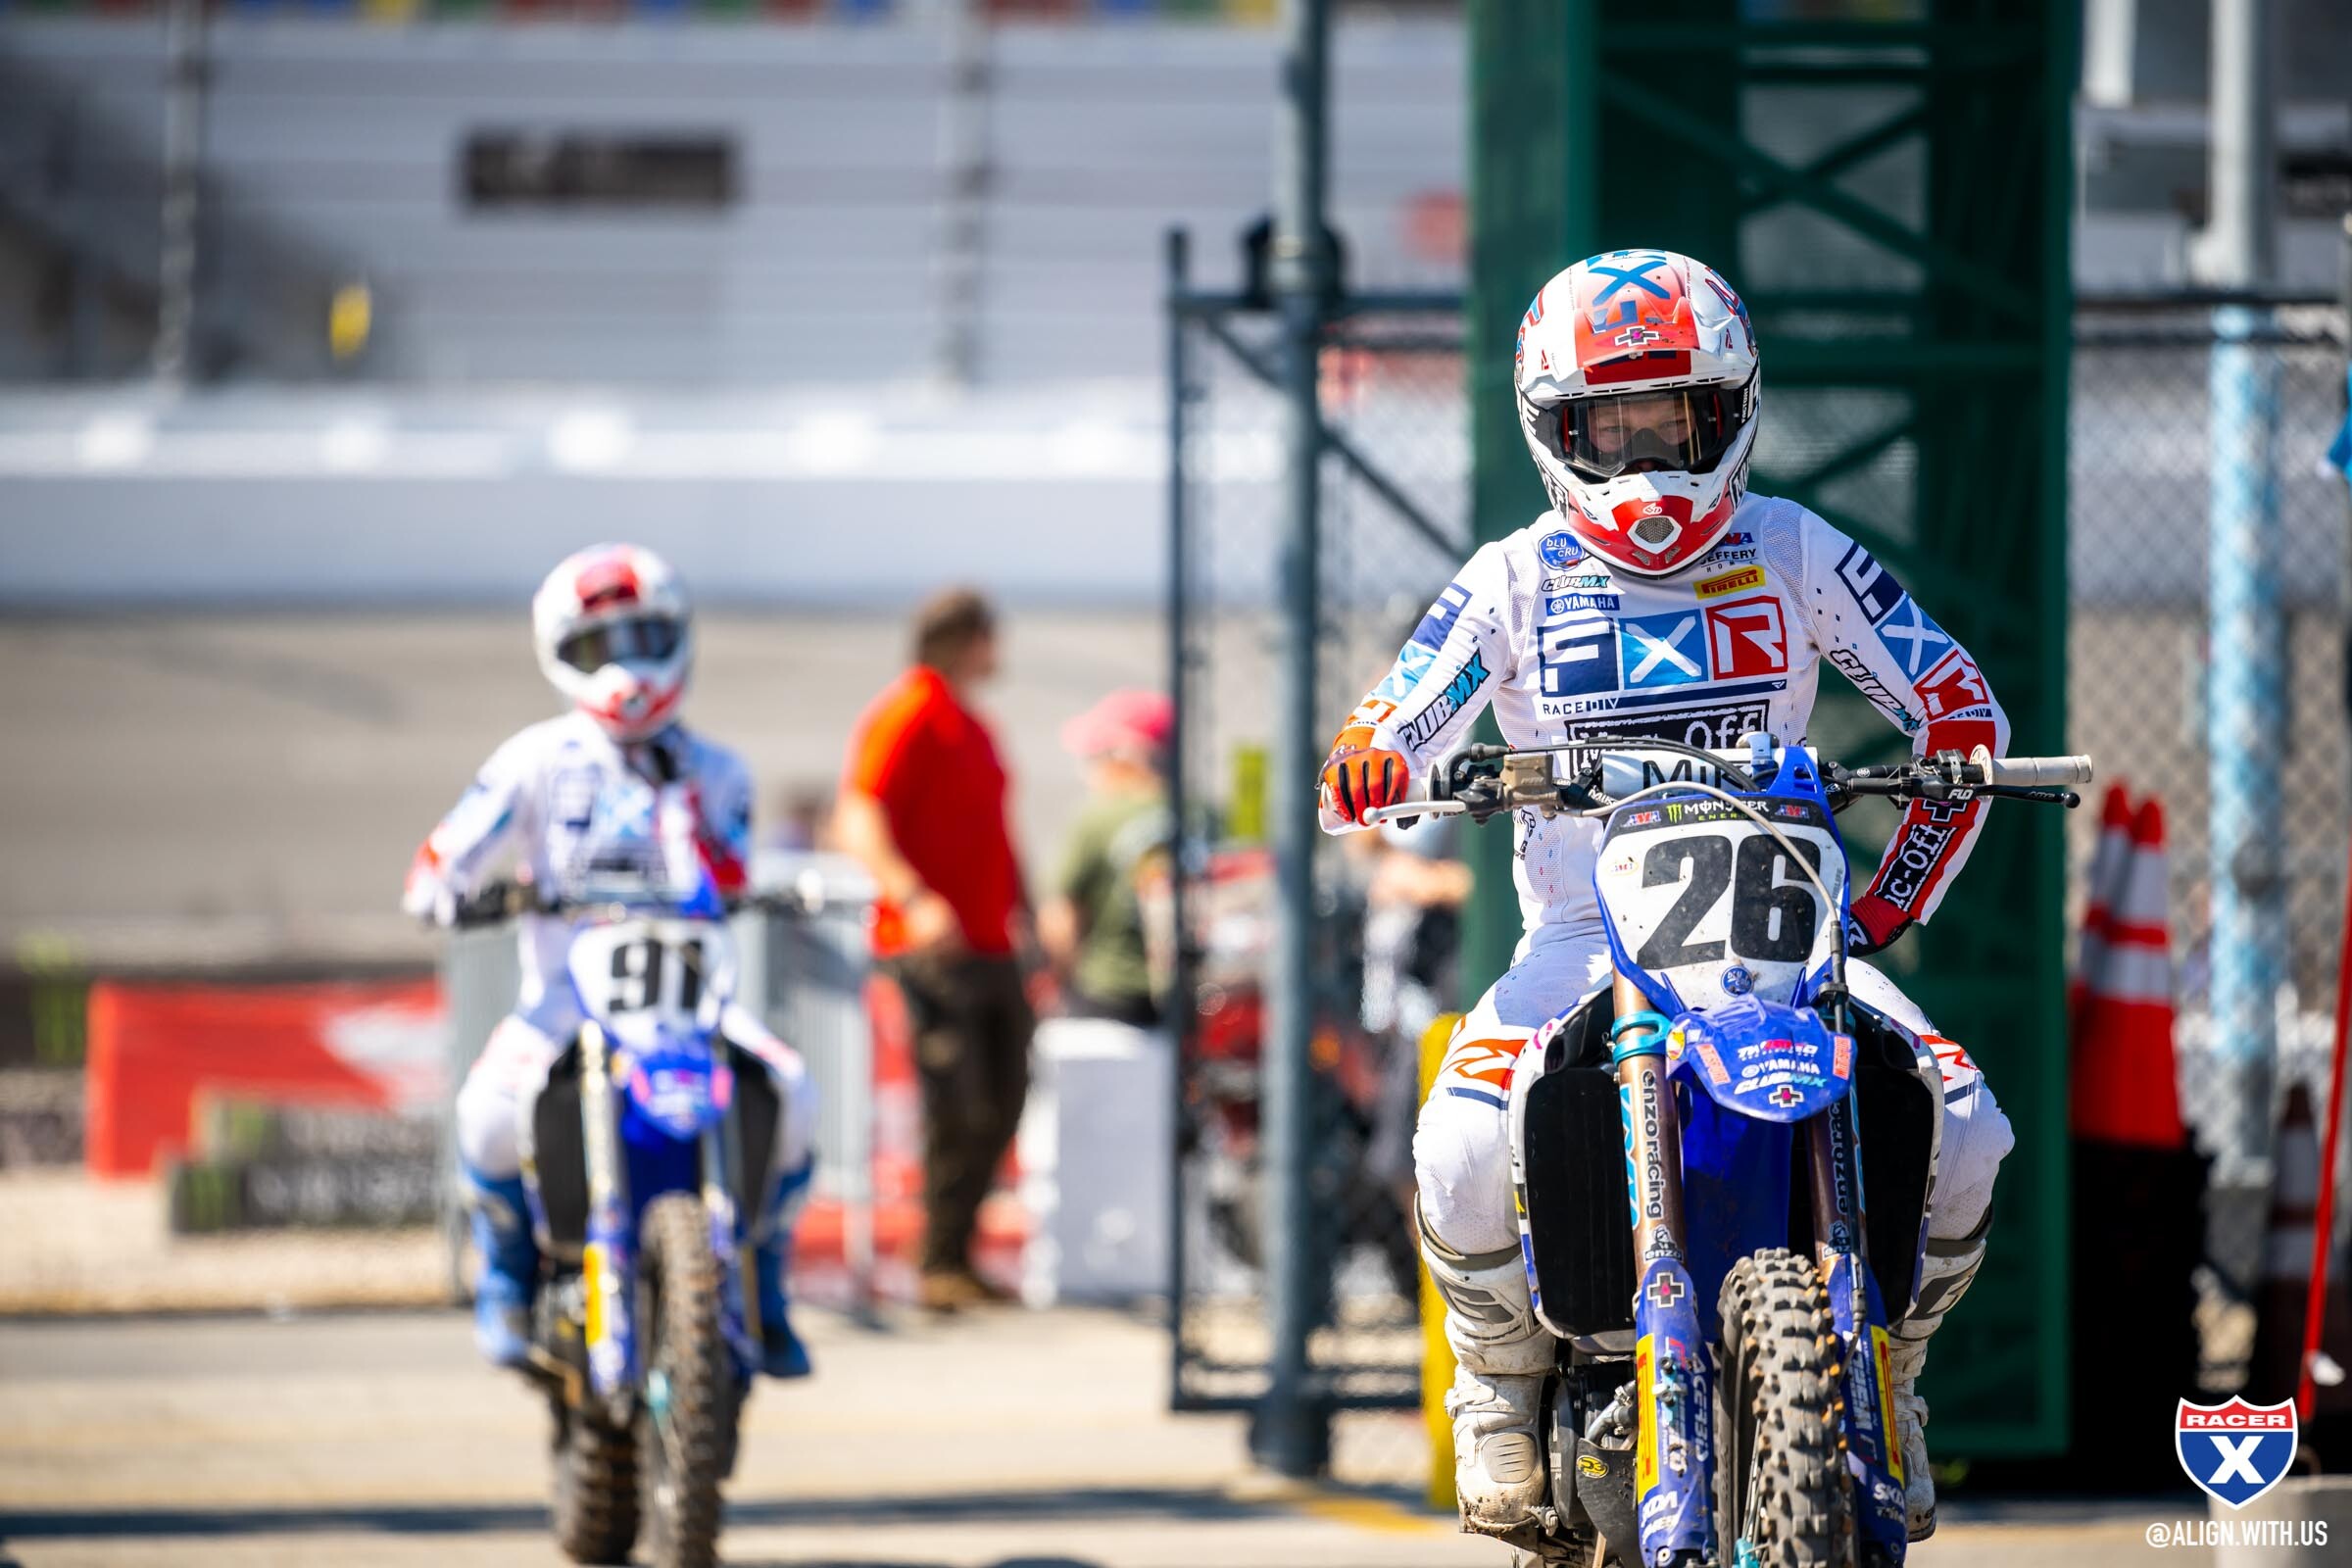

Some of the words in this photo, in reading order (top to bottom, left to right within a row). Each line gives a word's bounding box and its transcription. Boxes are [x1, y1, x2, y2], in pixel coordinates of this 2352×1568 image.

[1717, 532, 1755, 547] MA
[1701, 569, 1759, 594] PIRELLI
[1564, 595, 1615, 610] YAMAHA
[1537, 596, 1788, 697] FXR
[1948, 788, 1974, 800] FLO
[1684, 799, 1770, 816] MONER
[1697, 812, 1748, 822] ENER
[1637, 833, 1821, 970] 26
[609, 937, 702, 1012] 91
[1825, 1245, 1851, 1256] enz
